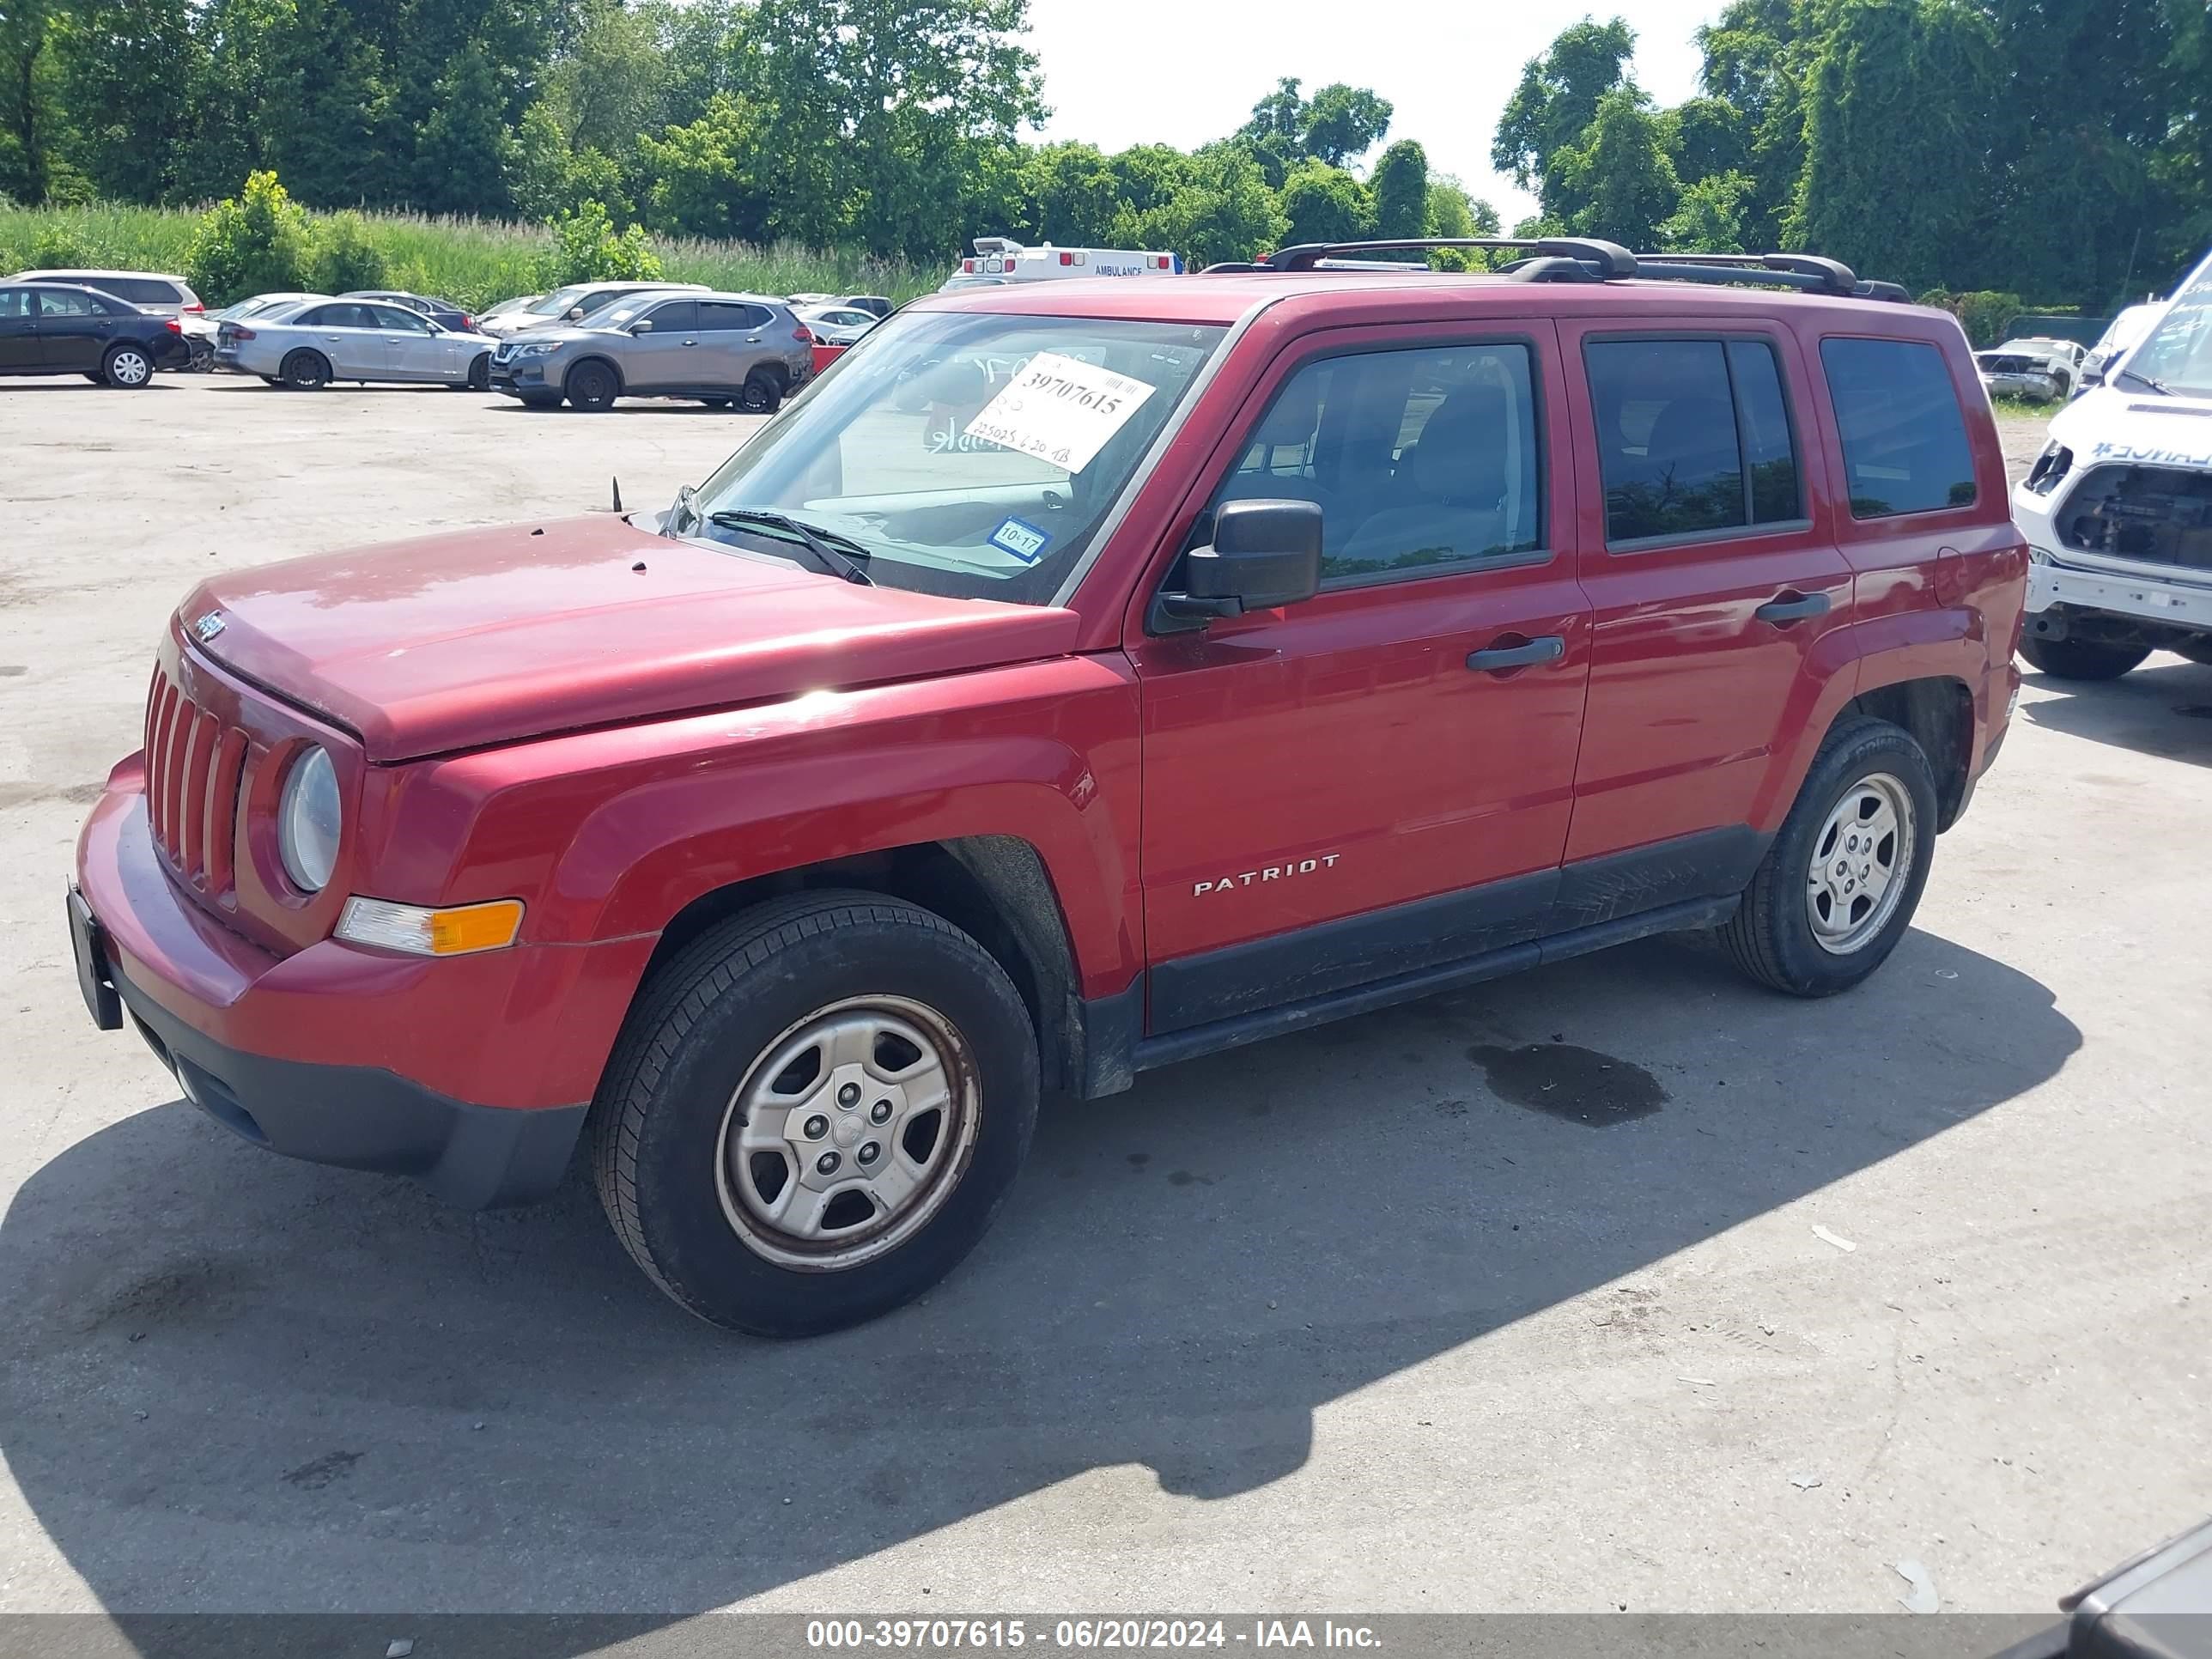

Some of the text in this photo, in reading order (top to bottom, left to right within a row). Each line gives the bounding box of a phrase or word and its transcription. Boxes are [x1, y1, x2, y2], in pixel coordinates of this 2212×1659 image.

[1095, 264, 1142, 276] AMBULANCE
[1022, 373, 1123, 416] 39707615
[1192, 854, 1341, 897] PATRIOT
